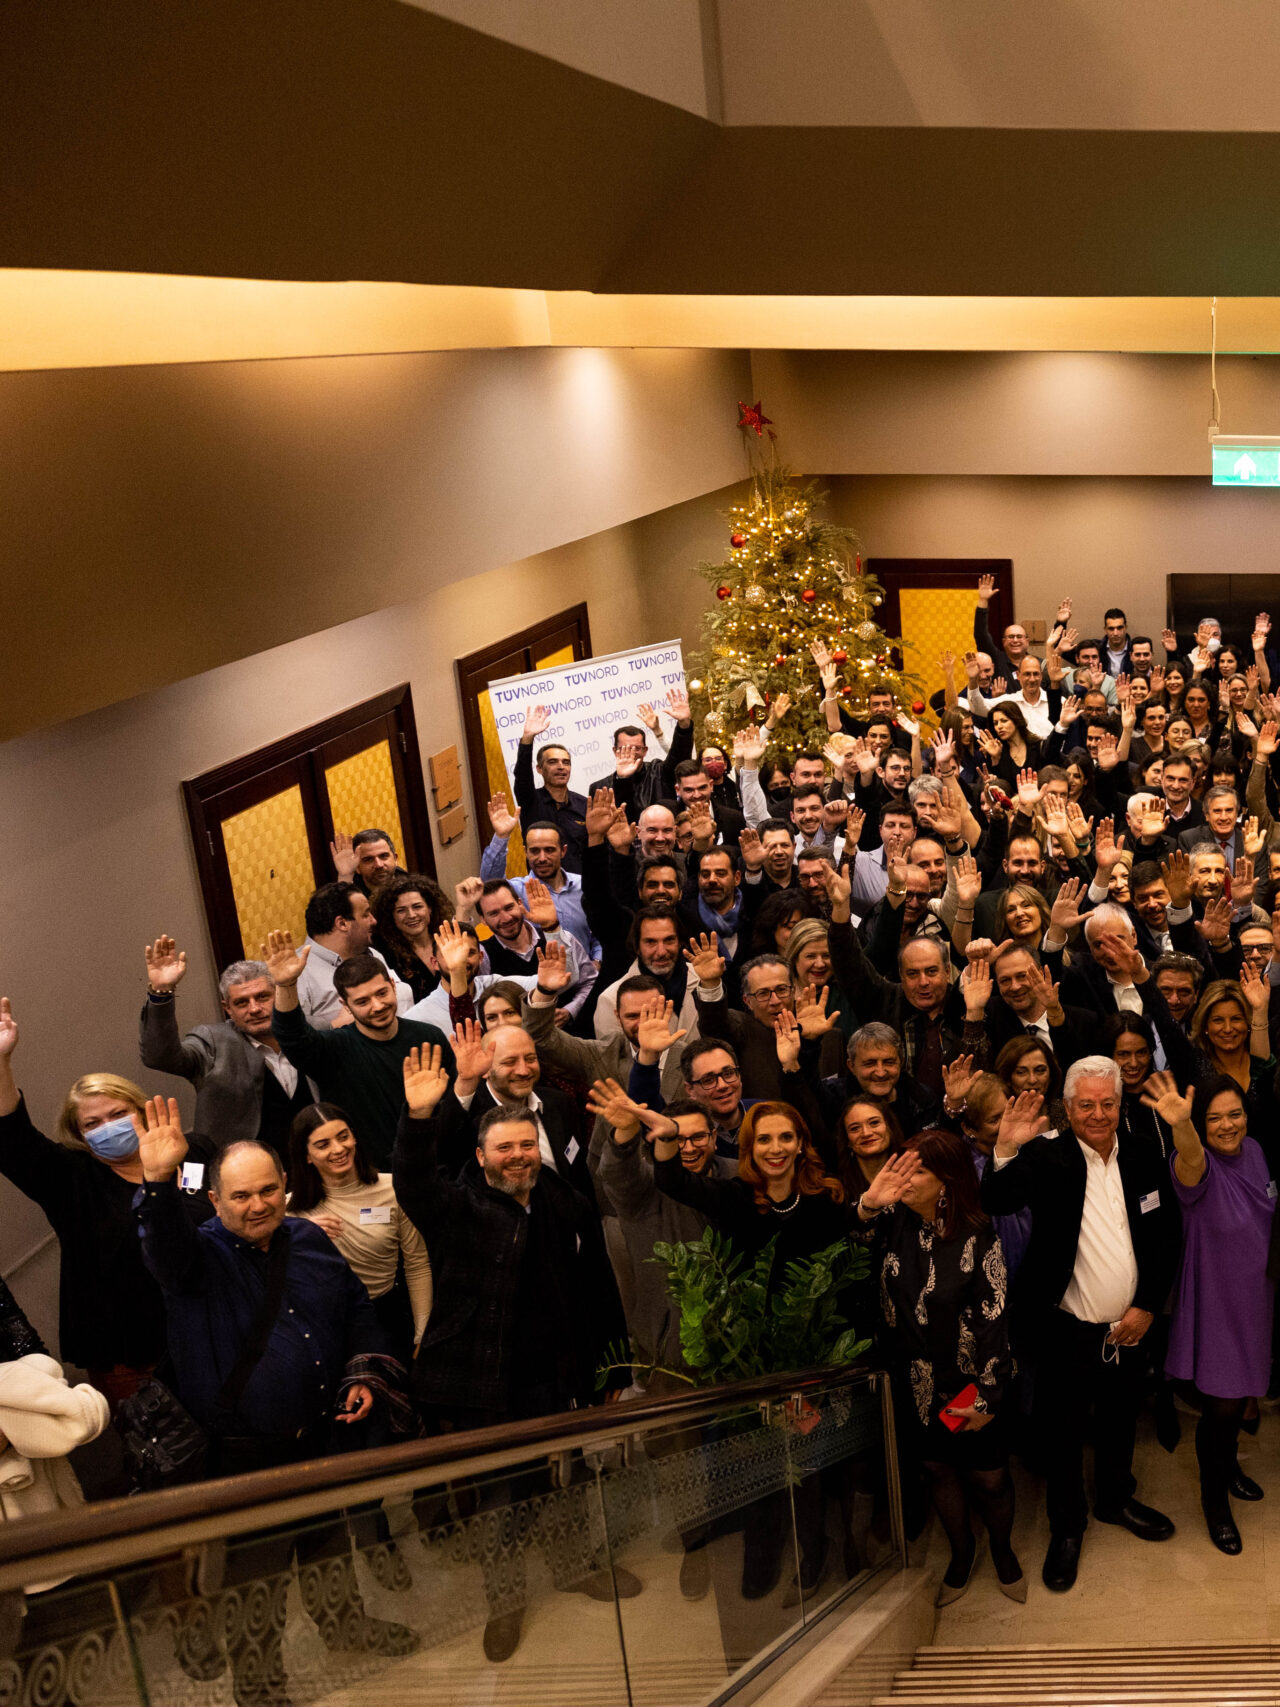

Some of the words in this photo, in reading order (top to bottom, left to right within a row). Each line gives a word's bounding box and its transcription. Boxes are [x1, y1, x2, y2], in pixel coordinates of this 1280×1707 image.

[628, 651, 678, 671] TÜVNORD
[564, 665, 619, 687] TÜVNORD
[495, 680, 555, 704] TÜVNORD
[600, 680, 652, 702] TÜVNORD
[575, 709, 629, 732] TÜVNORD
